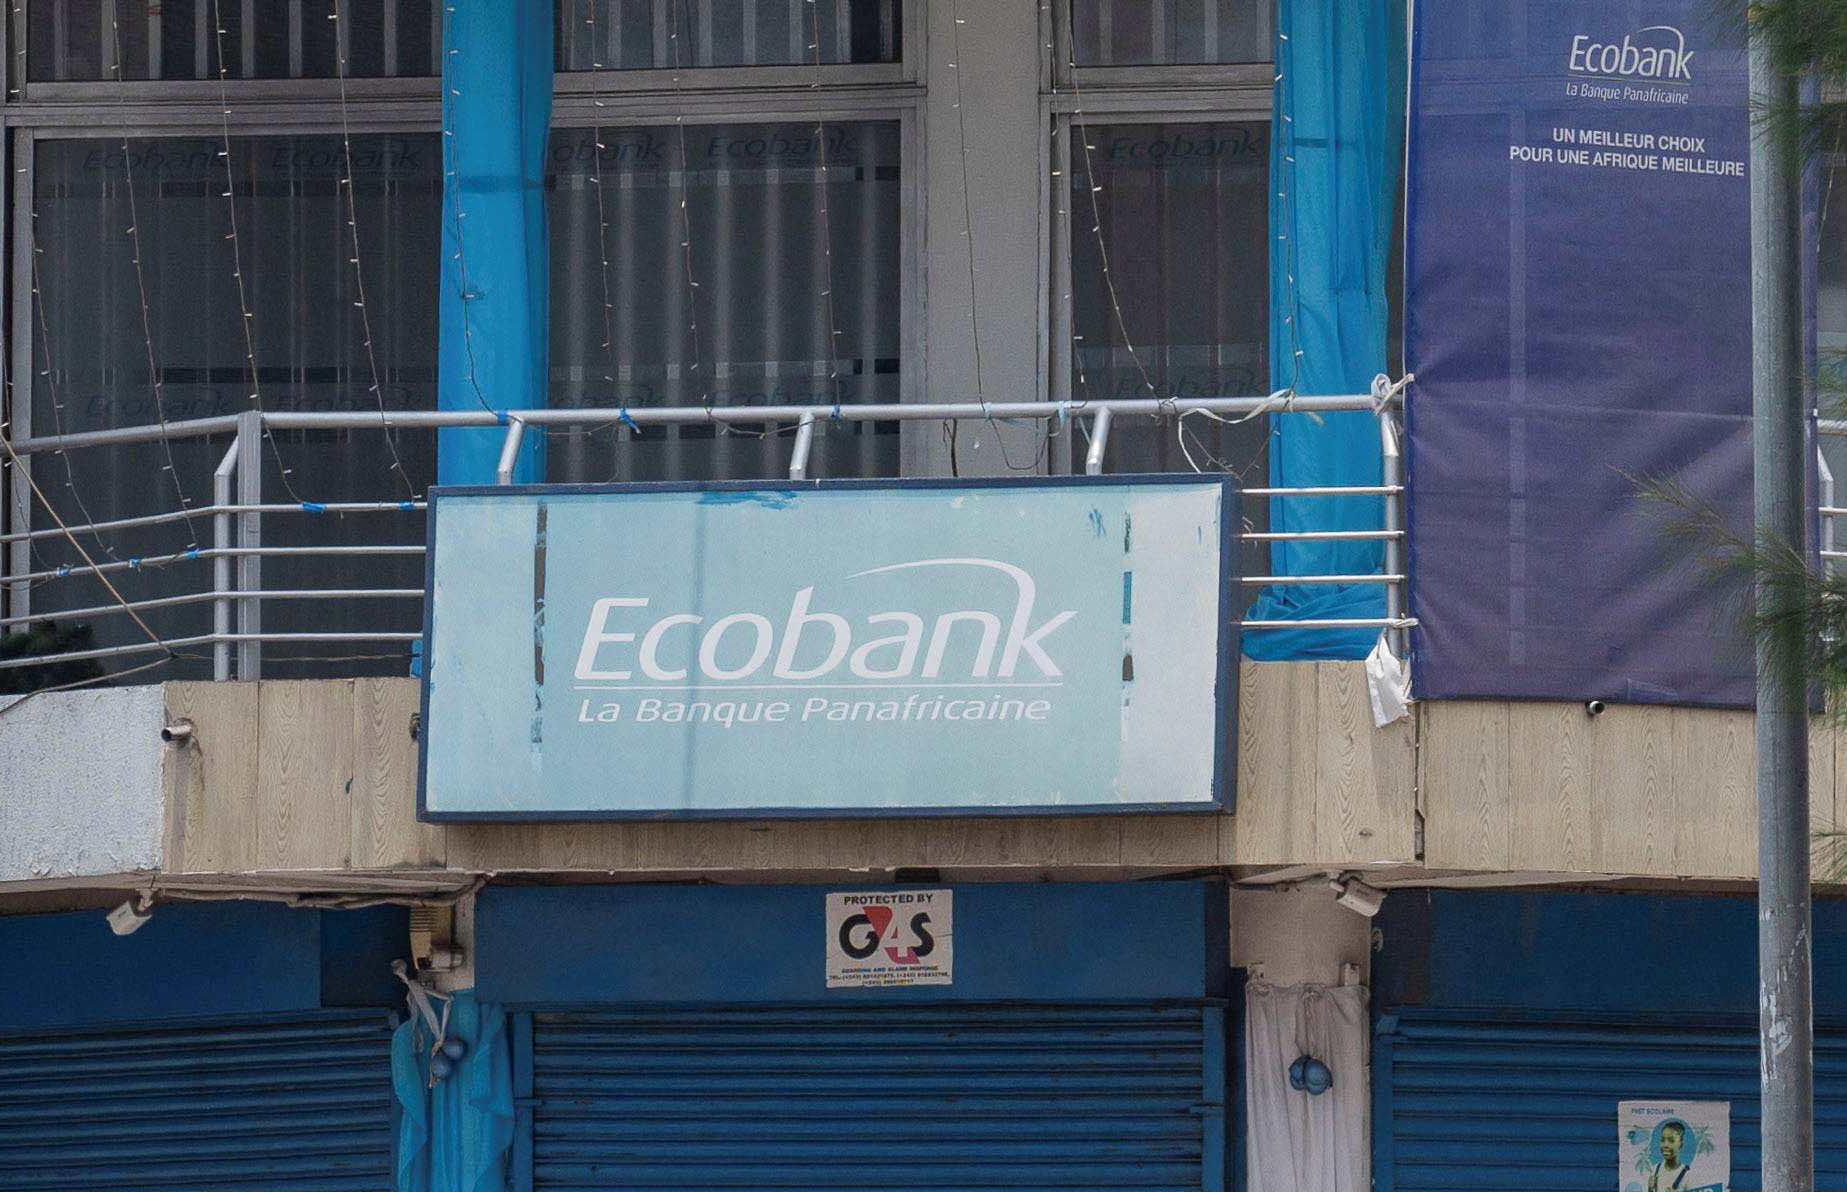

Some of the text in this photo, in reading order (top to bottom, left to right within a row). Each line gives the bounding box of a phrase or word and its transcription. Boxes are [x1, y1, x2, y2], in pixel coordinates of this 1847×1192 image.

[1568, 25, 1695, 80] Ecobank
[1565, 82, 1689, 105] La Banque Panafricaine
[1112, 127, 1263, 160] Ecobank
[1553, 127, 1705, 153] UN MEILLEUR CHOIX
[1509, 146, 1744, 177] POUR UNE AFRIQUE MEILLEURE
[573, 557, 1078, 682] Ecobank
[578, 693, 1051, 728] La Banque Panafricaine
[844, 894, 933, 905] PROTECTED BY
[839, 906, 935, 965] G4S
